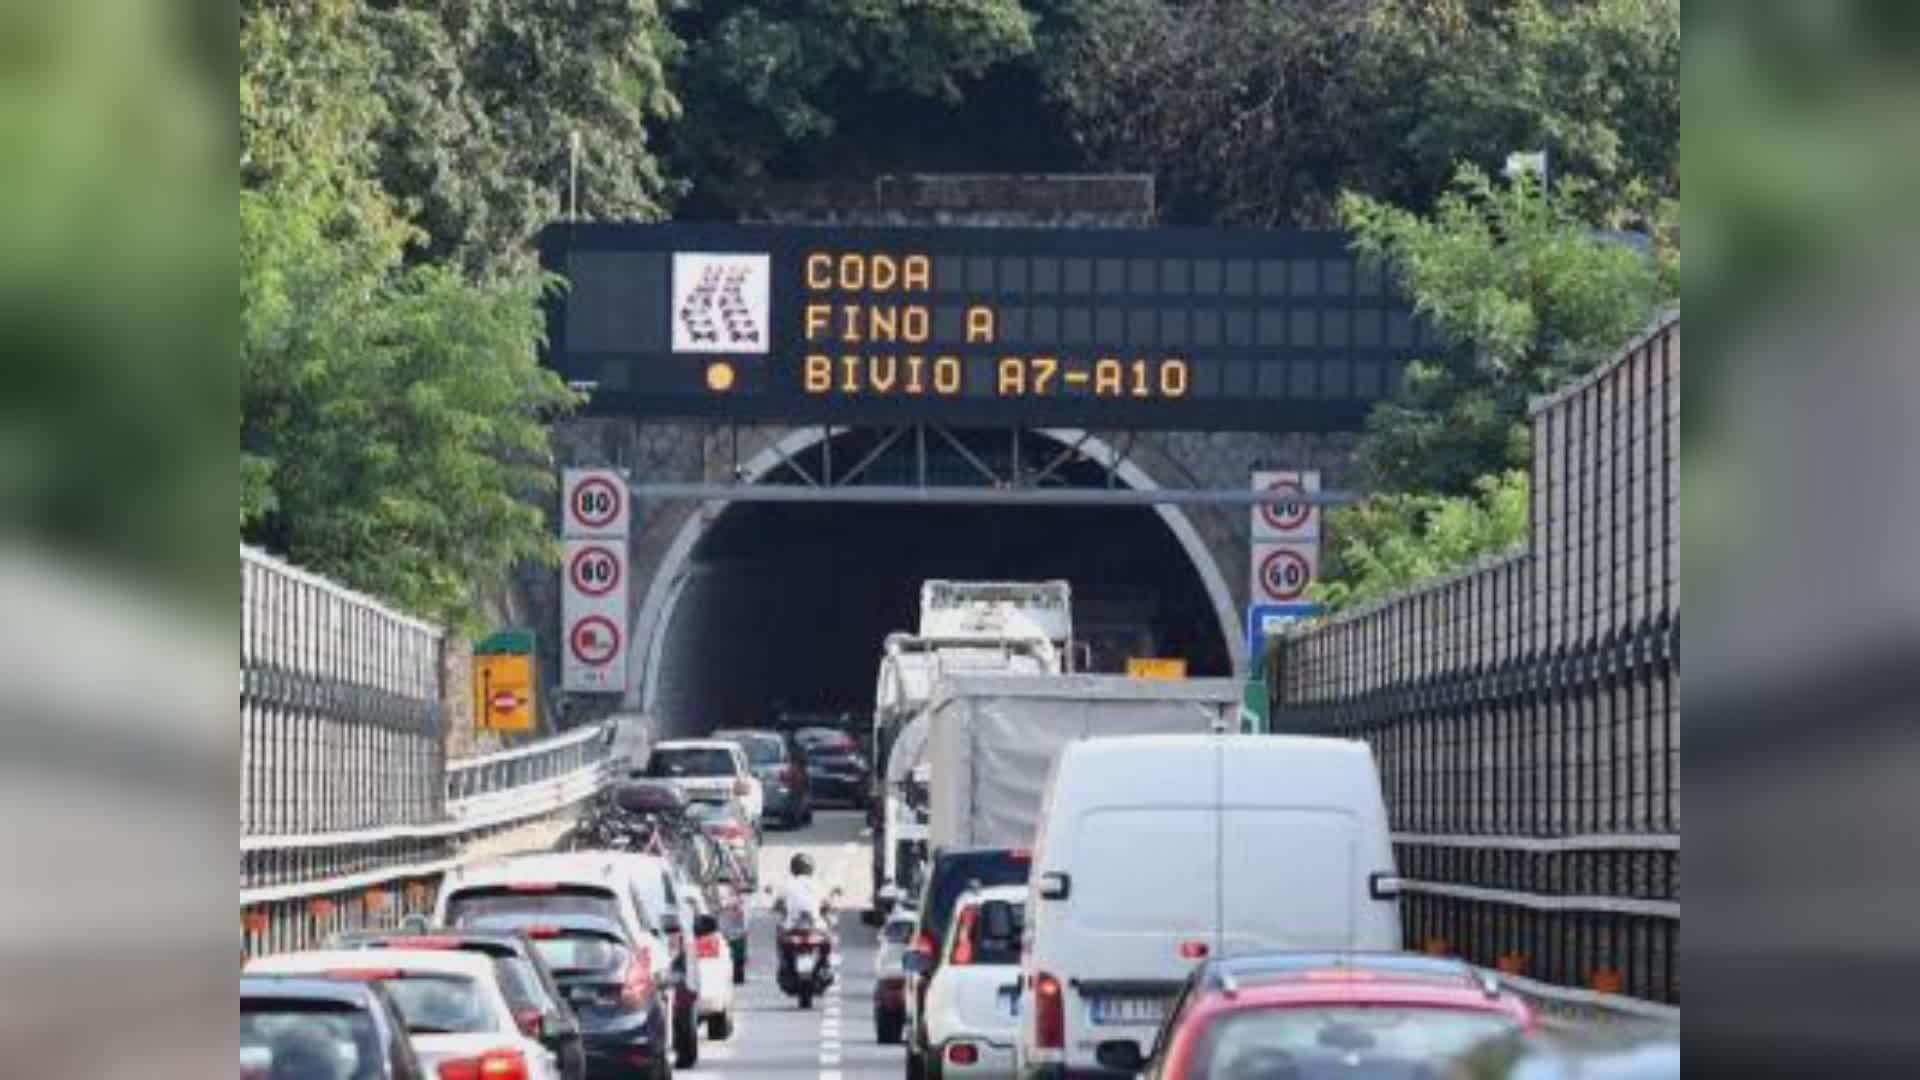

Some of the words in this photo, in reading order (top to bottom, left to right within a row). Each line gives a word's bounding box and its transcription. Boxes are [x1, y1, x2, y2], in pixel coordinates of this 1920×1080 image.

[806, 254, 930, 291] CODA
[805, 304, 930, 343] FINO
[967, 305, 996, 343] A
[804, 356, 961, 394] BIVIO
[998, 357, 1189, 396] A7-A10
[1269, 563, 1299, 586] 60
